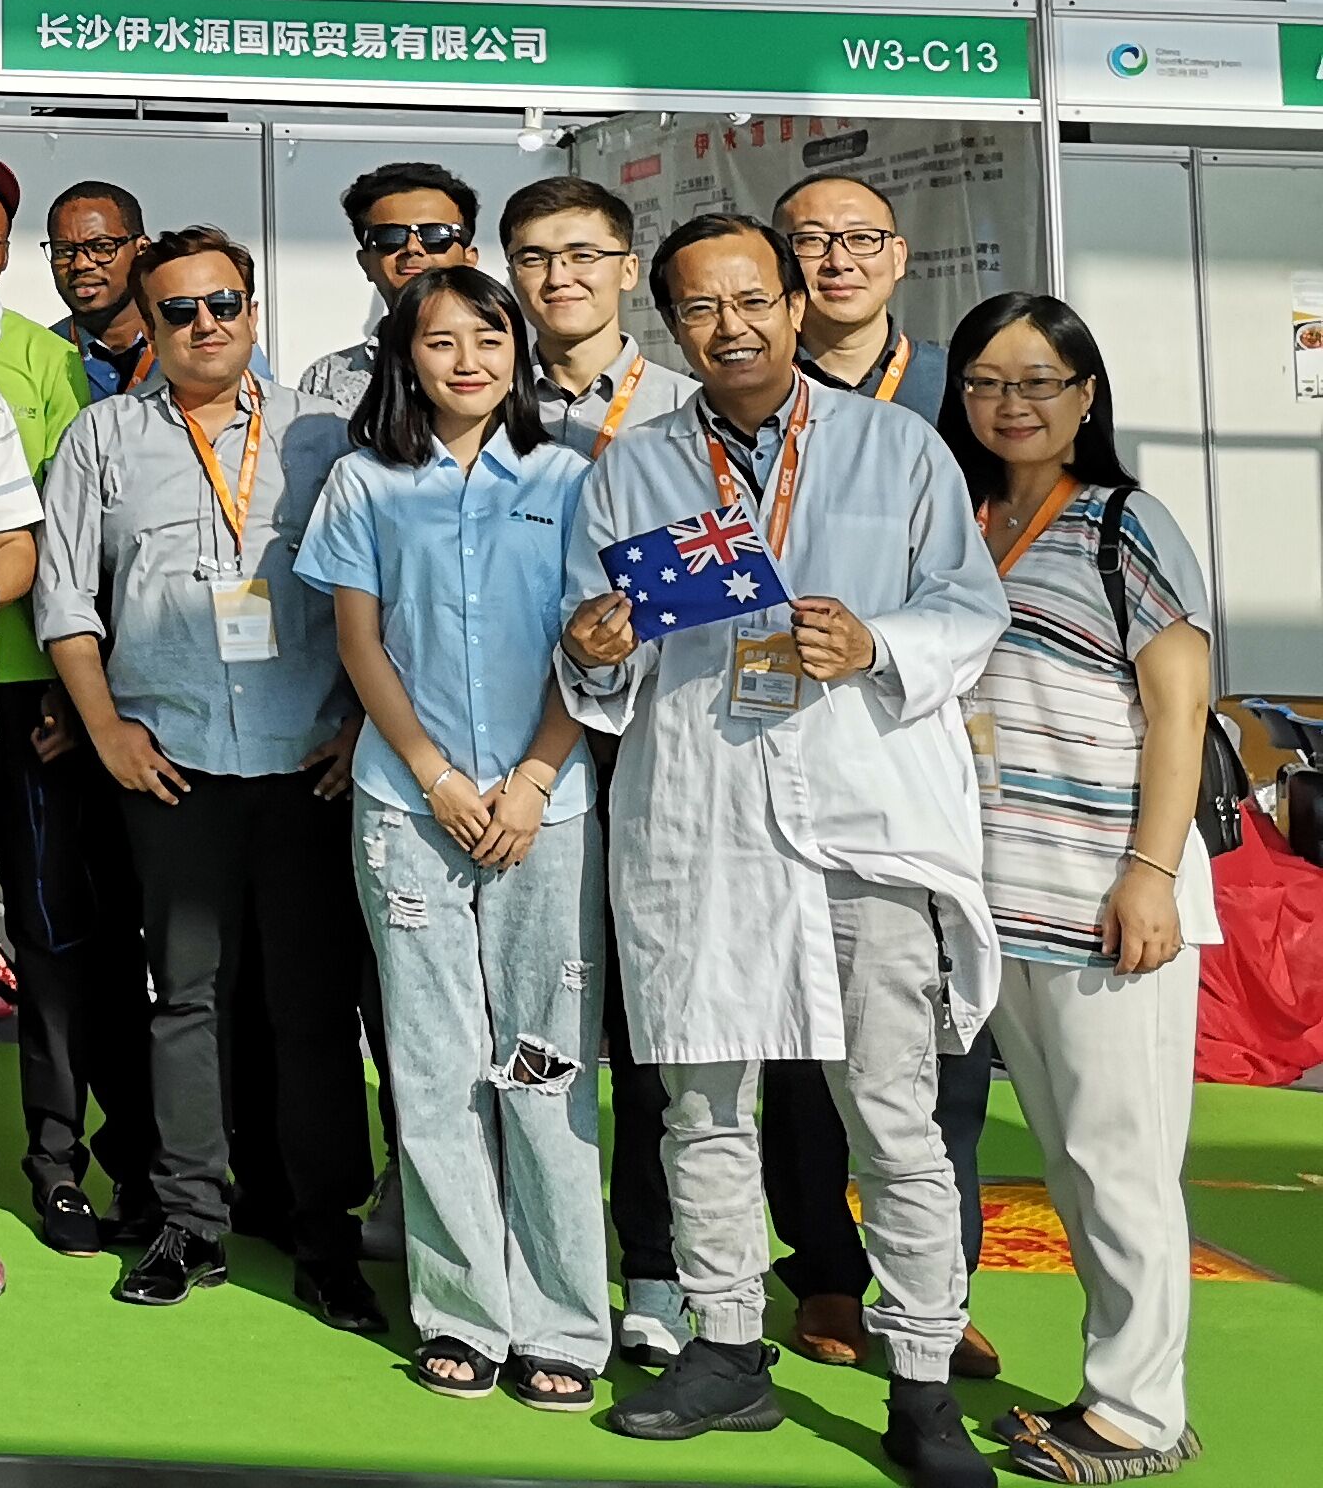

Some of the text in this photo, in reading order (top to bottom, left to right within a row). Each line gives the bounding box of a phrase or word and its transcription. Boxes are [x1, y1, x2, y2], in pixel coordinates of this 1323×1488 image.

[36, 13, 548, 64] 长沙伊水源国际贸易有限公司
[842, 38, 999, 73] W3-C13
